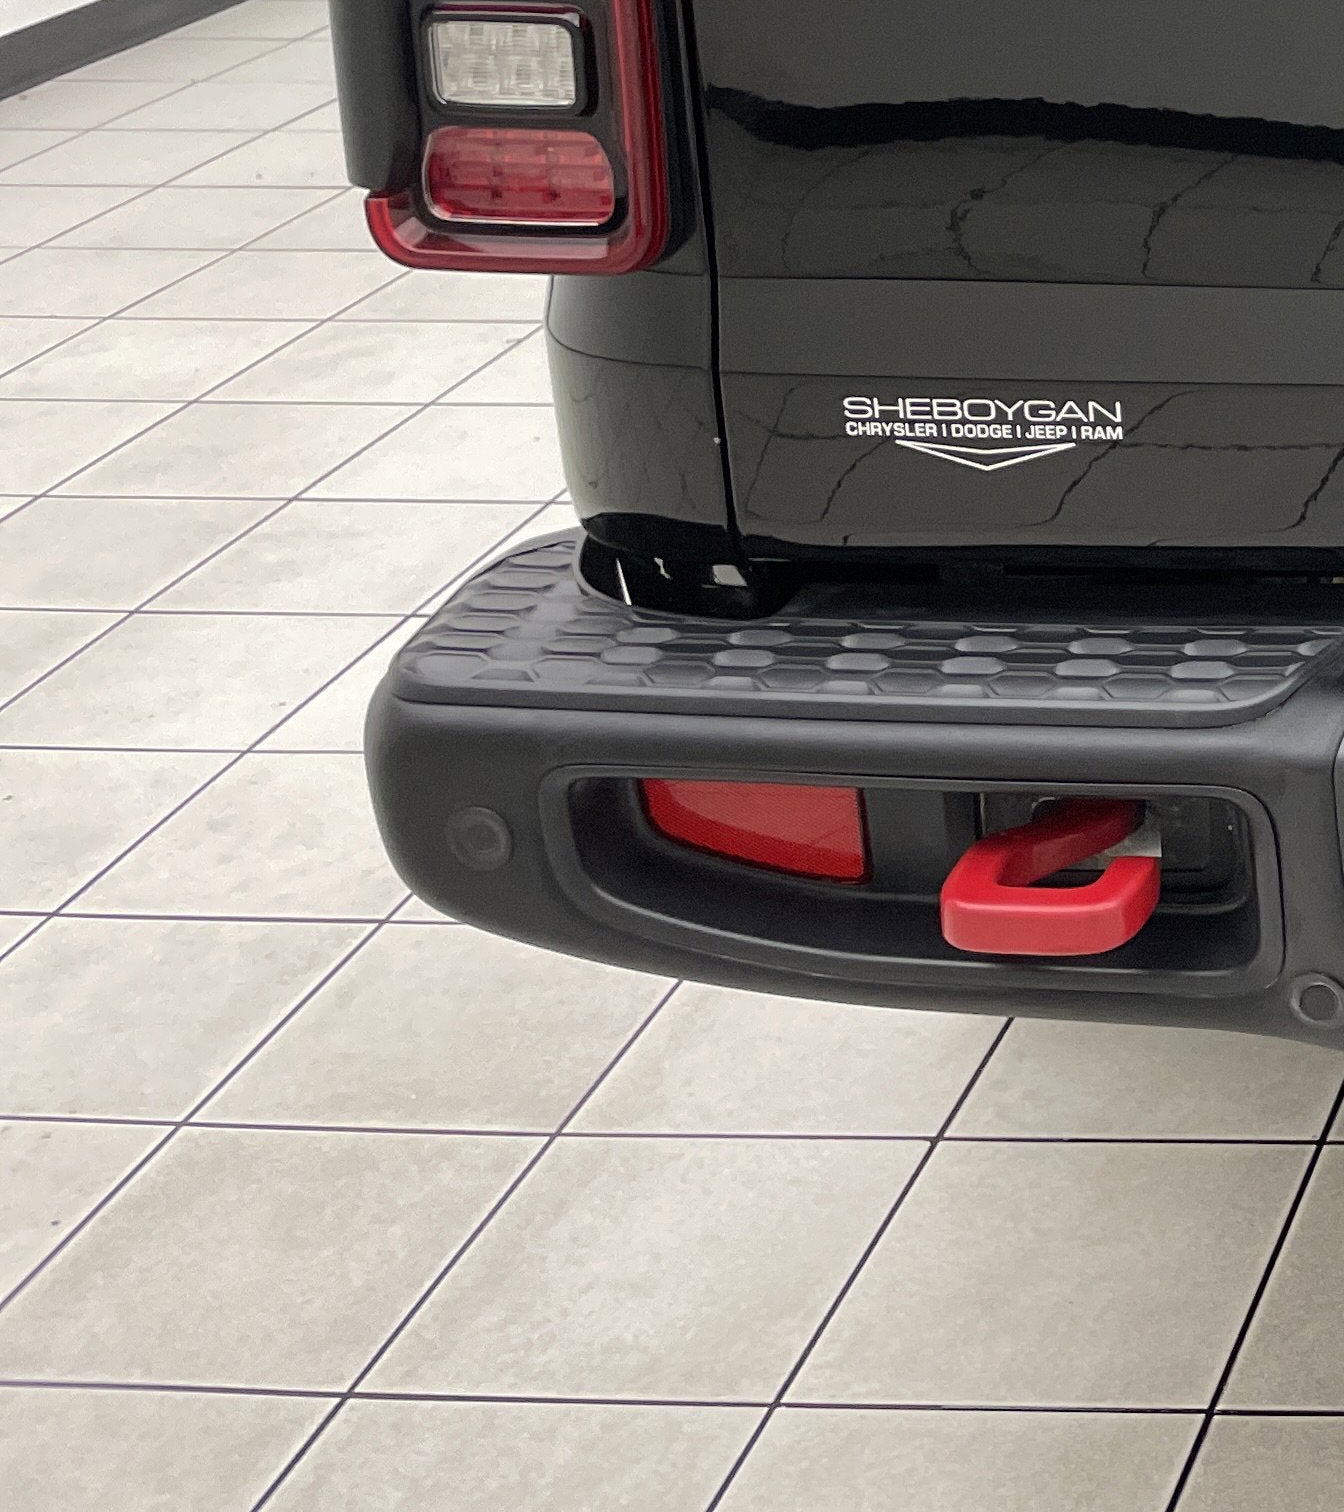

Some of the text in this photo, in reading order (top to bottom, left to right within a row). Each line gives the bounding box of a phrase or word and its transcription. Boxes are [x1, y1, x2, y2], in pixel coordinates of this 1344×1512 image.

[842, 396, 1122, 423] SHEBOYGAN
[845, 422, 1123, 440] CHRYSLER DODGE JEEP RAM
